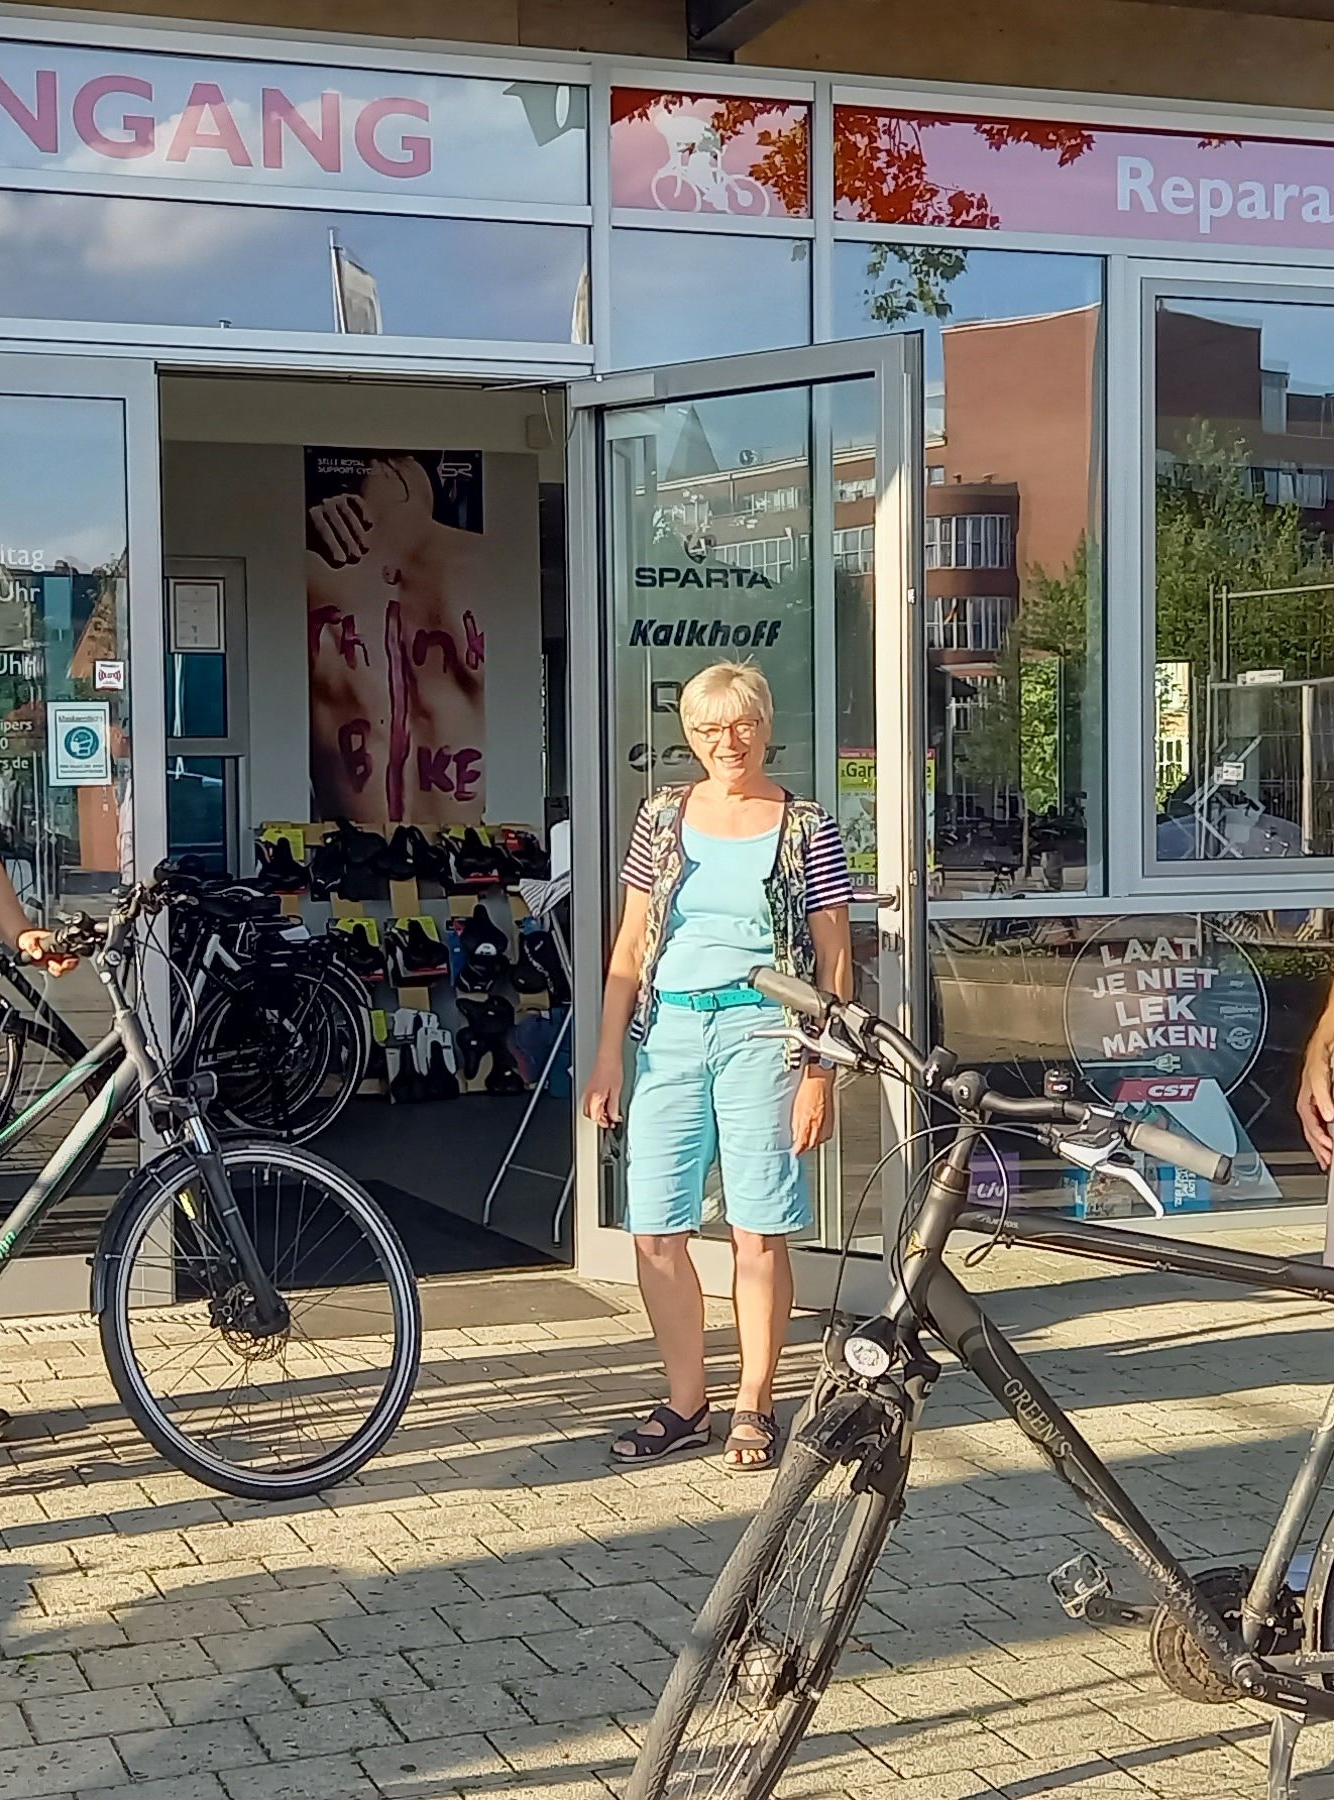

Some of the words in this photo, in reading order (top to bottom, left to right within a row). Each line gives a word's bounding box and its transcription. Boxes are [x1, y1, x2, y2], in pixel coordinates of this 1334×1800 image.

[635, 567, 773, 589] SPARTA
[629, 618, 782, 647] Kalkhoff
[1100, 937, 1198, 968] LAAT
[1092, 976, 1127, 1000] JE
[1137, 966, 1219, 993] NIET
[1115, 994, 1198, 1028] LEK
[1101, 1025, 1218, 1060] MAKEN!
[1147, 1082, 1196, 1099] CST
[1003, 1378, 1073, 1460] GREEN'S
